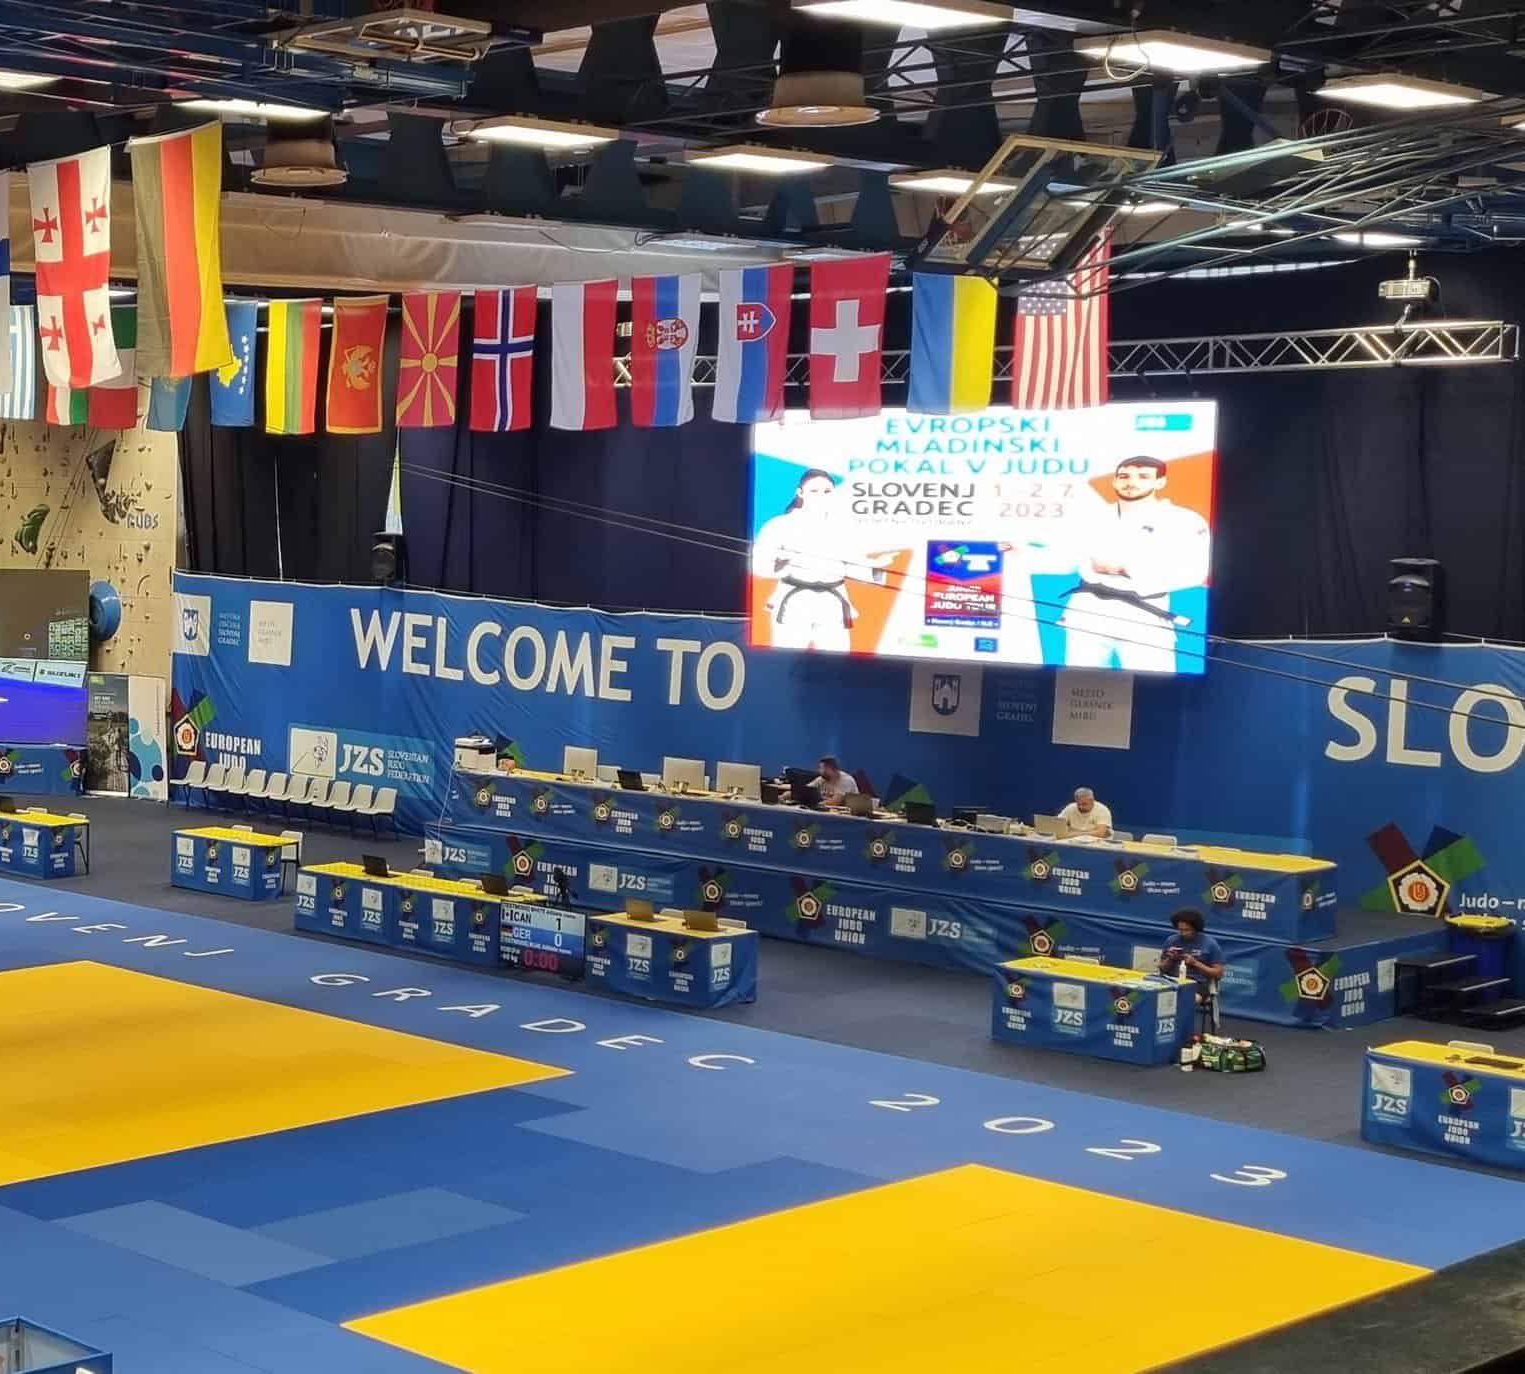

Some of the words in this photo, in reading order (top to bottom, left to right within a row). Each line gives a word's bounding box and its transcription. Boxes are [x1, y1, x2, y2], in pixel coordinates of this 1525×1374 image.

[886, 416, 1051, 435] EVROPSKI
[876, 437, 1060, 455] MLADINSKI
[848, 458, 954, 475] POKAL
[964, 458, 987, 475] V
[1001, 458, 1091, 476] JUDU
[852, 482, 975, 498] SLOVENJ
[852, 500, 974, 516] GRADEC
[1000, 502, 1064, 518] 2023
[350, 608, 636, 702] WELCOME
[656, 639, 746, 711] TO
[1325, 676, 1525, 773] SLO
[205, 731, 262, 756] EUROPEAN
[339, 743, 384, 777] JZS
[178, 856, 193, 868] JZS
[443, 848, 467, 863] JZS
[234, 866, 250, 879] JZS
[1052, 867, 1090, 880] EUROPEAN
[618, 873, 646, 890] JZS
[297, 895, 315, 909] JZS
[1235, 890, 1276, 904] EUROPEAN
[1459, 893, 1499, 909] Judo
[362, 911, 382, 924] JZS
[826, 904, 876, 921] EUROPEAN
[1242, 910, 1267, 920] UNION
[434, 921, 454, 935] JZS
[514, 911, 532, 924] CAN
[556, 918, 562, 931] 1
[838, 918, 863, 932] JUDO
[928, 918, 962, 939] JZS
[513, 926, 531, 941] GER
[554, 933, 562, 948] 0
[834, 930, 866, 945] UNION
[523, 949, 560, 972] 0:00
[627, 958, 650, 973] JZS
[712, 967, 731, 983] JZS
[1334, 971, 1371, 991] EUROPEAN
[1053, 1008, 1083, 1026] JZS
[1341, 1001, 1366, 1018] UNION
[307, 971, 757, 1072] GRADEC
[1156, 1019, 1176, 1035] JZS
[1371, 1092, 1408, 1115] JZS
[1438, 1114, 1480, 1130] EUROPEAN
[1448, 1123, 1469, 1136] JUDO
[867, 1093, 1289, 1186] 2023
[1444, 1133, 1471, 1145] UNION
